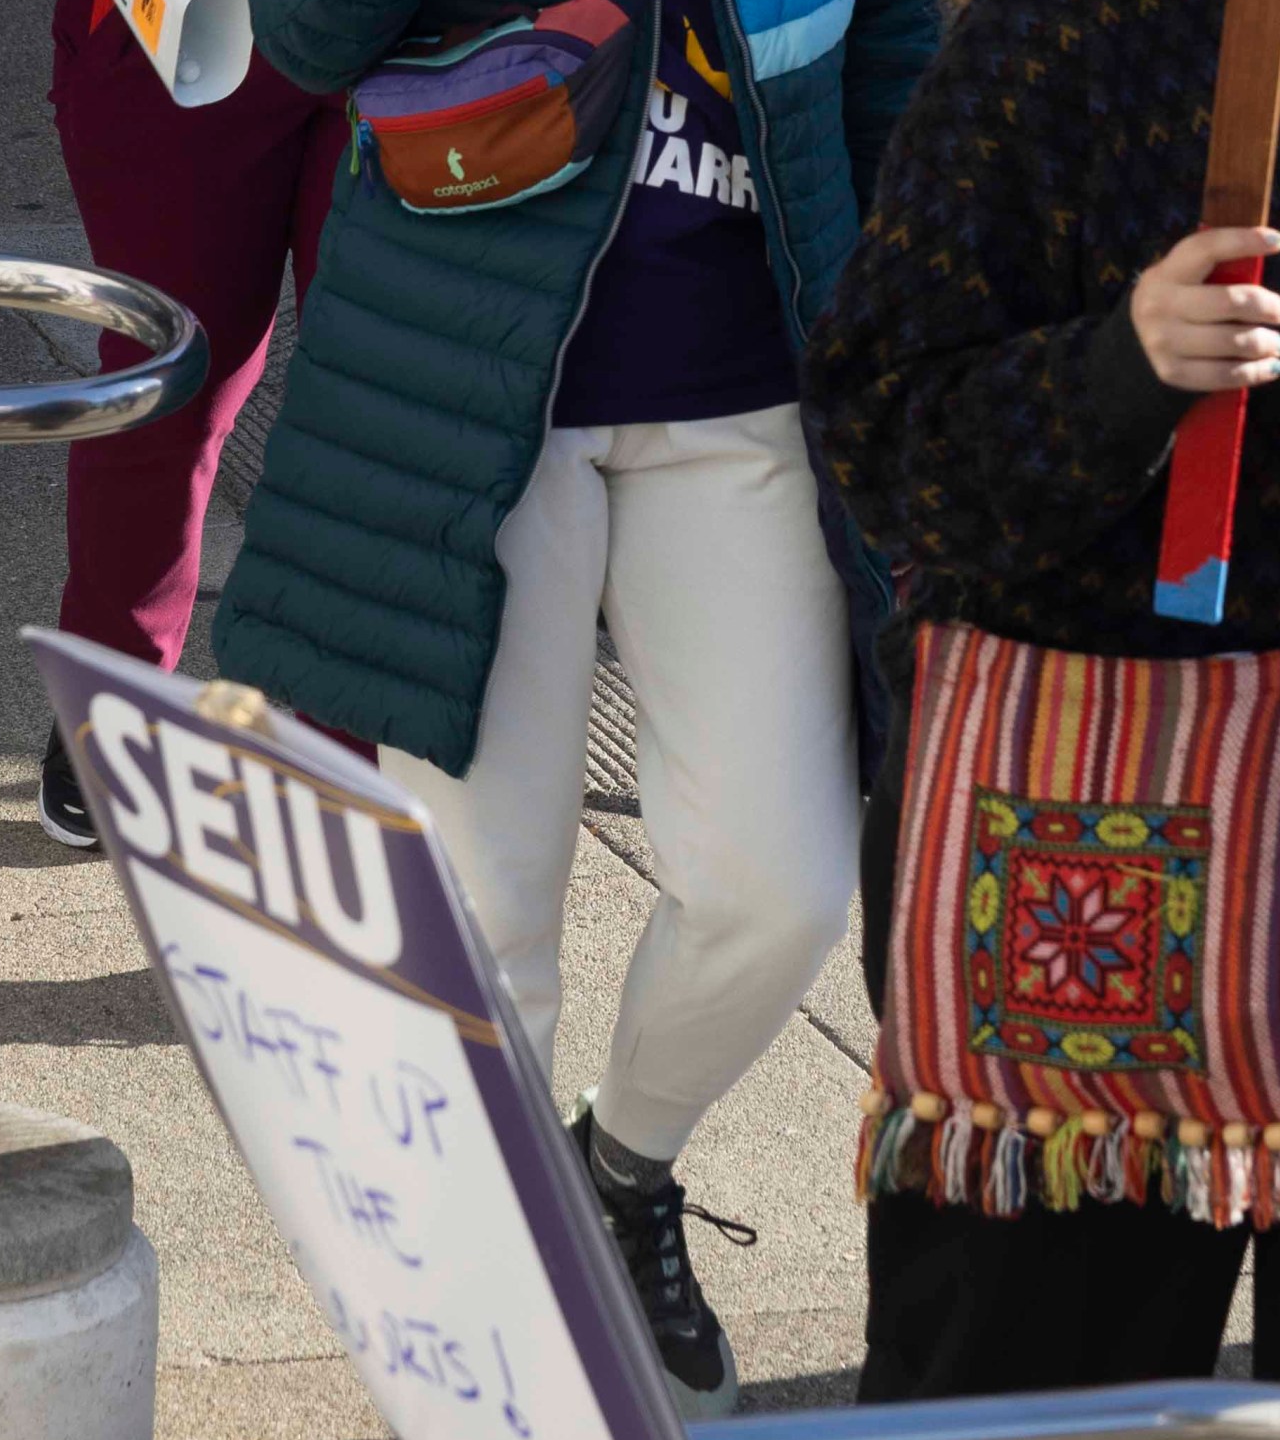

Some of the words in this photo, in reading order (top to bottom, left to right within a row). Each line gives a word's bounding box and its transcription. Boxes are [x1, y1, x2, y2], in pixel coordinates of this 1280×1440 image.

[433, 174, 499, 197] cotopaxi
[89, 691, 403, 968] SEIU
[368, 1058, 450, 1160] UP
[292, 1134, 425, 1272] THE
